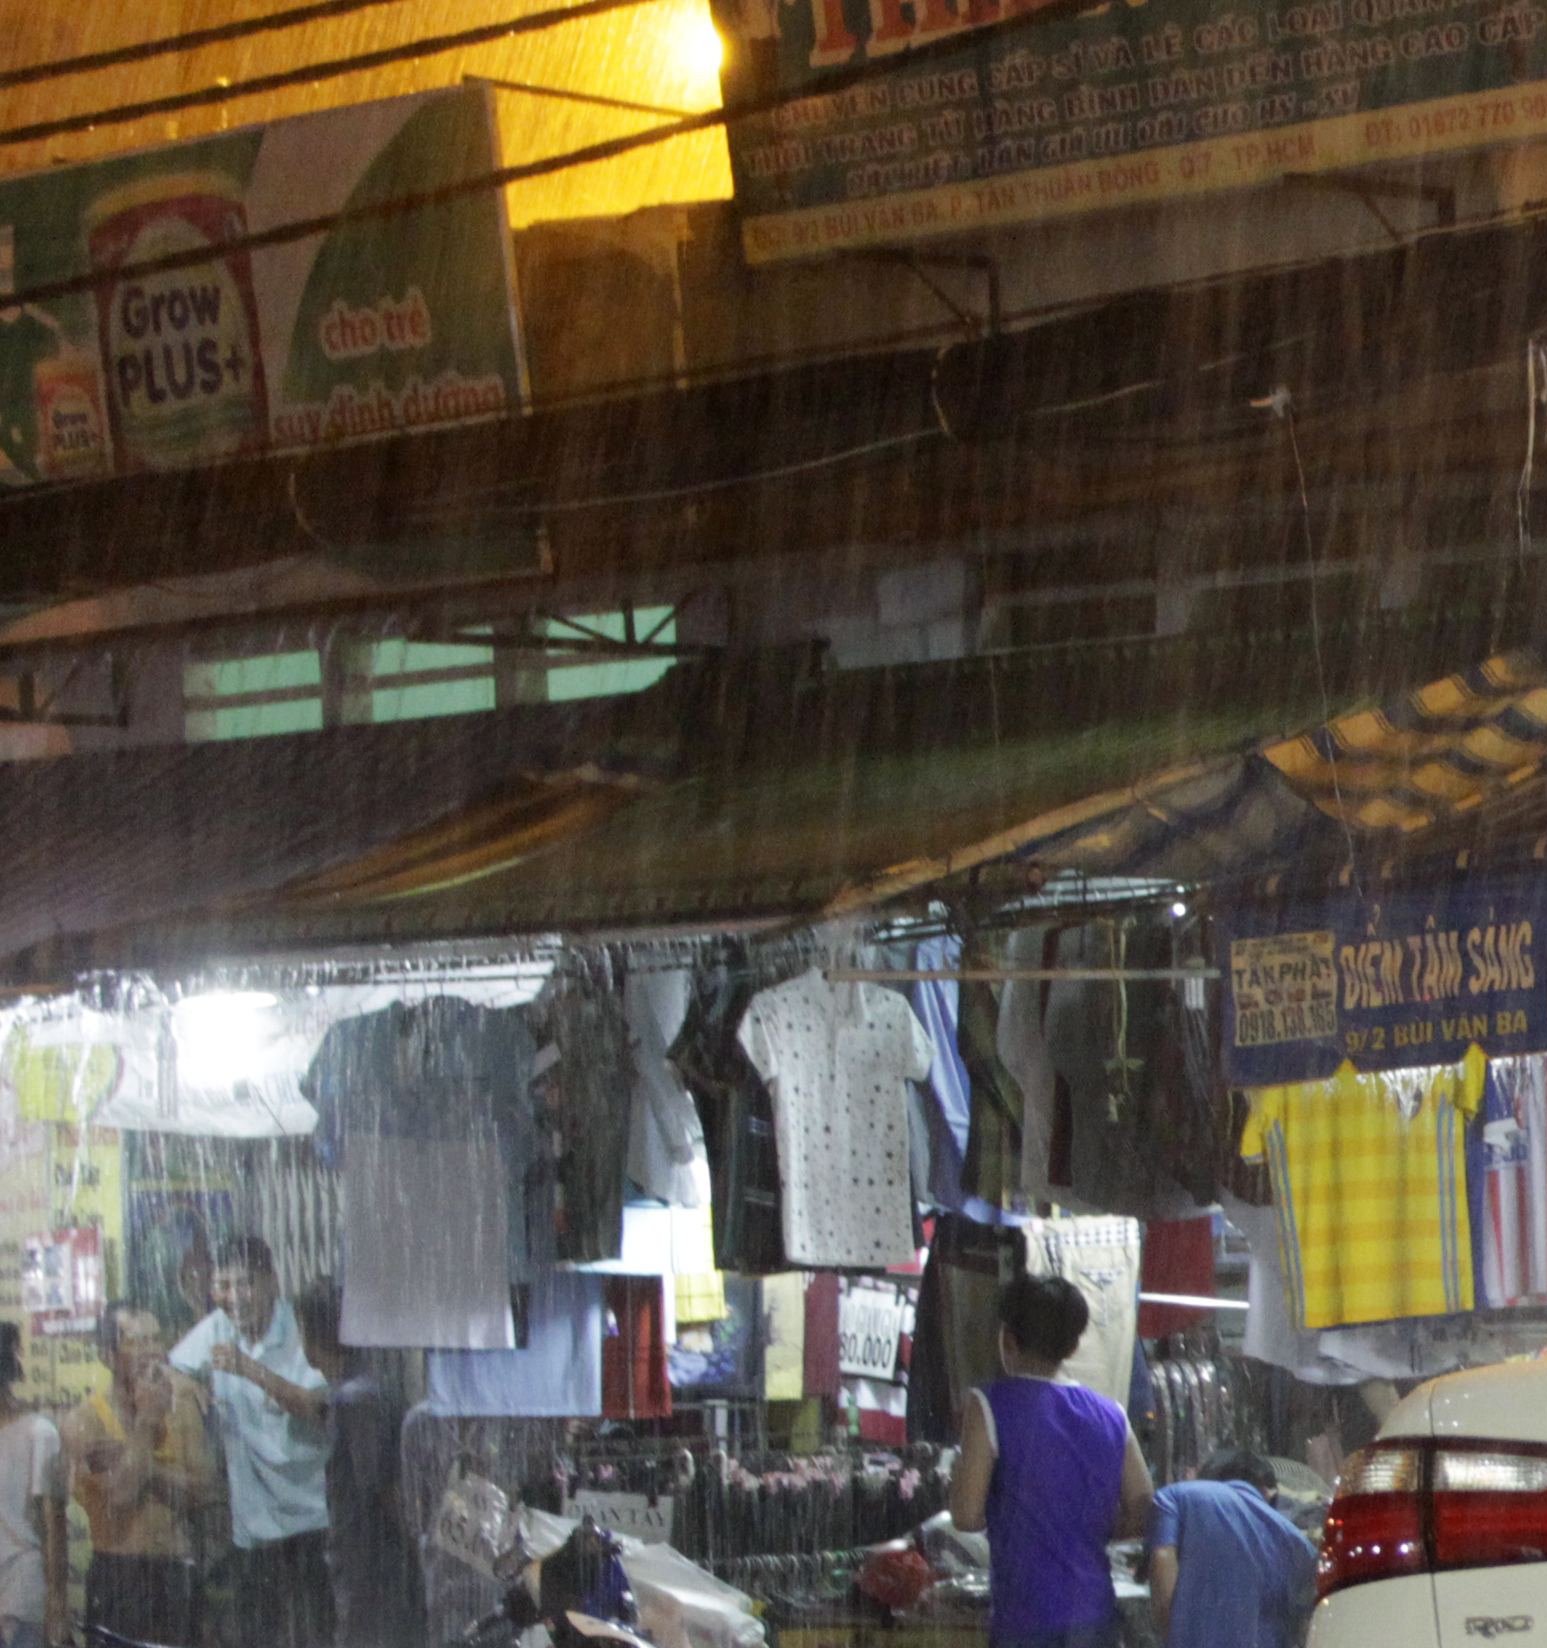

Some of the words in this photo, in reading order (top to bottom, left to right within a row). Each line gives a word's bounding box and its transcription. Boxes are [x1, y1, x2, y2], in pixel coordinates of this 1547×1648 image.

[1397, 22, 1467, 63] CAO
[120, 284, 222, 340] Grow
[321, 303, 379, 352] cho
[116, 338, 246, 408] PLUS+
[1467, 905, 1536, 996] SÁNG
[1345, 1028, 1386, 1054] 9/2
[1496, 1009, 1529, 1034] BA
